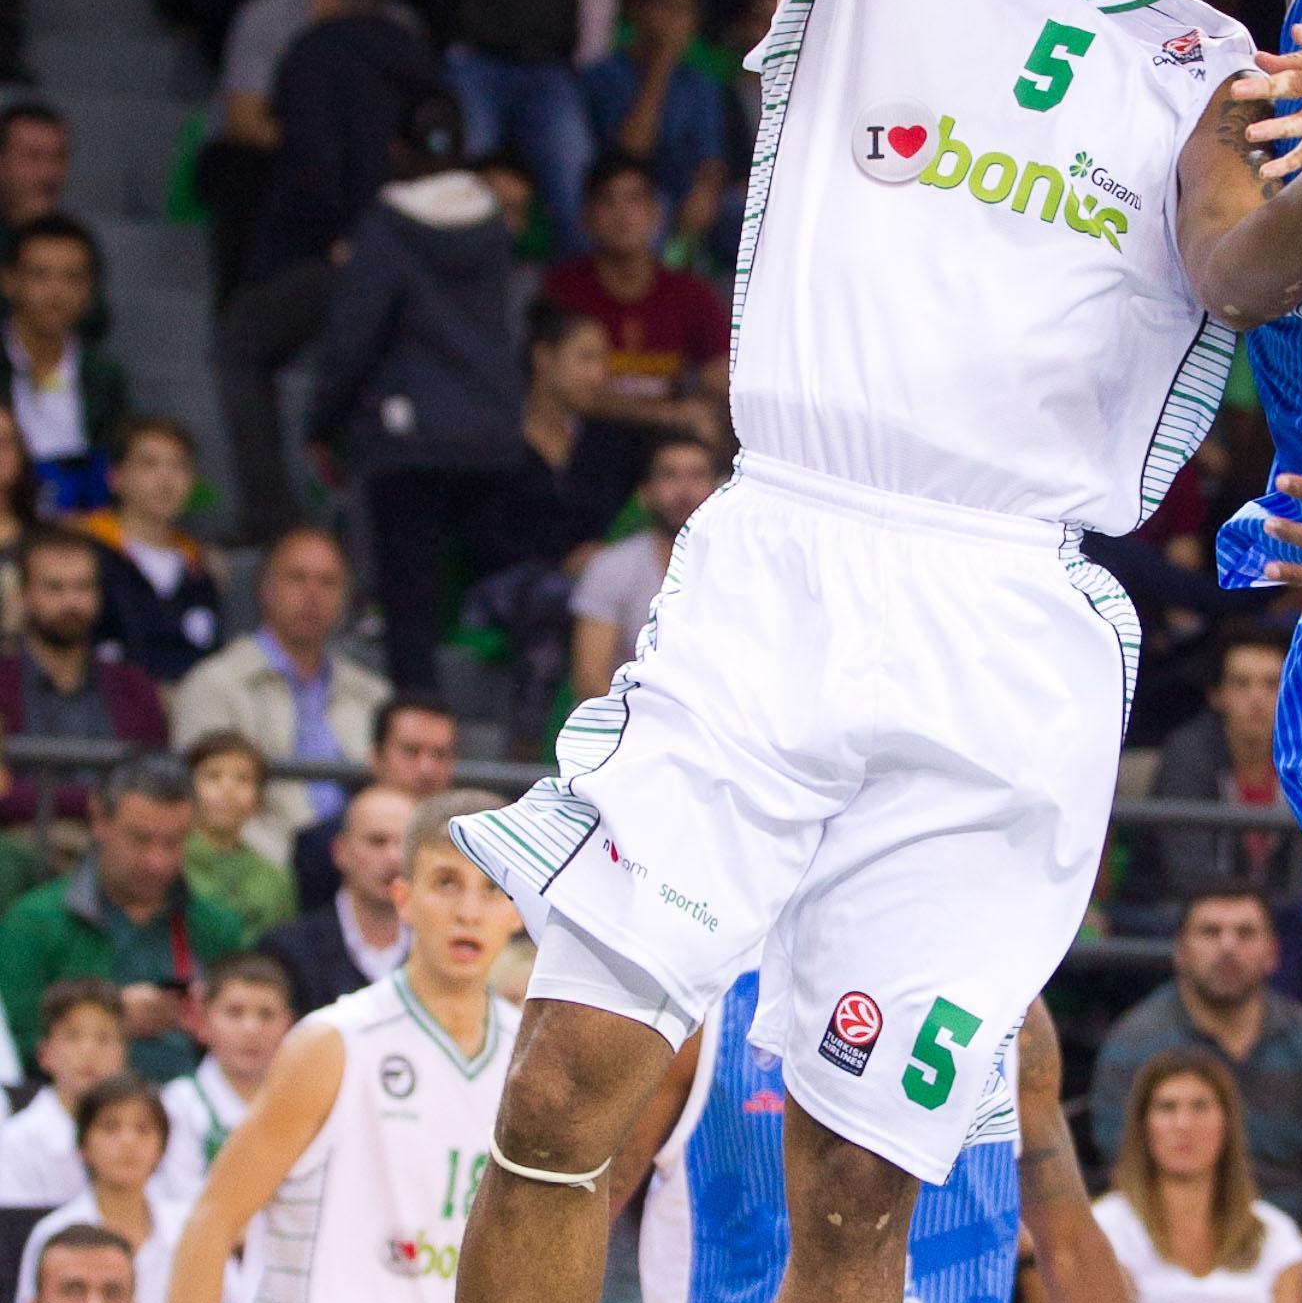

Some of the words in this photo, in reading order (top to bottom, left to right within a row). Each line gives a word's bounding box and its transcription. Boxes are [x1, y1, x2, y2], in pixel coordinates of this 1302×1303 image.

[1013, 19, 1096, 112] 5
[866, 126, 885, 160] I
[918, 114, 1128, 254] bonus
[659, 883, 718, 933] sportive
[822, 1039, 864, 1069] AIRLINES
[825, 1032, 868, 1061] TURKISH
[902, 995, 983, 1111] 5
